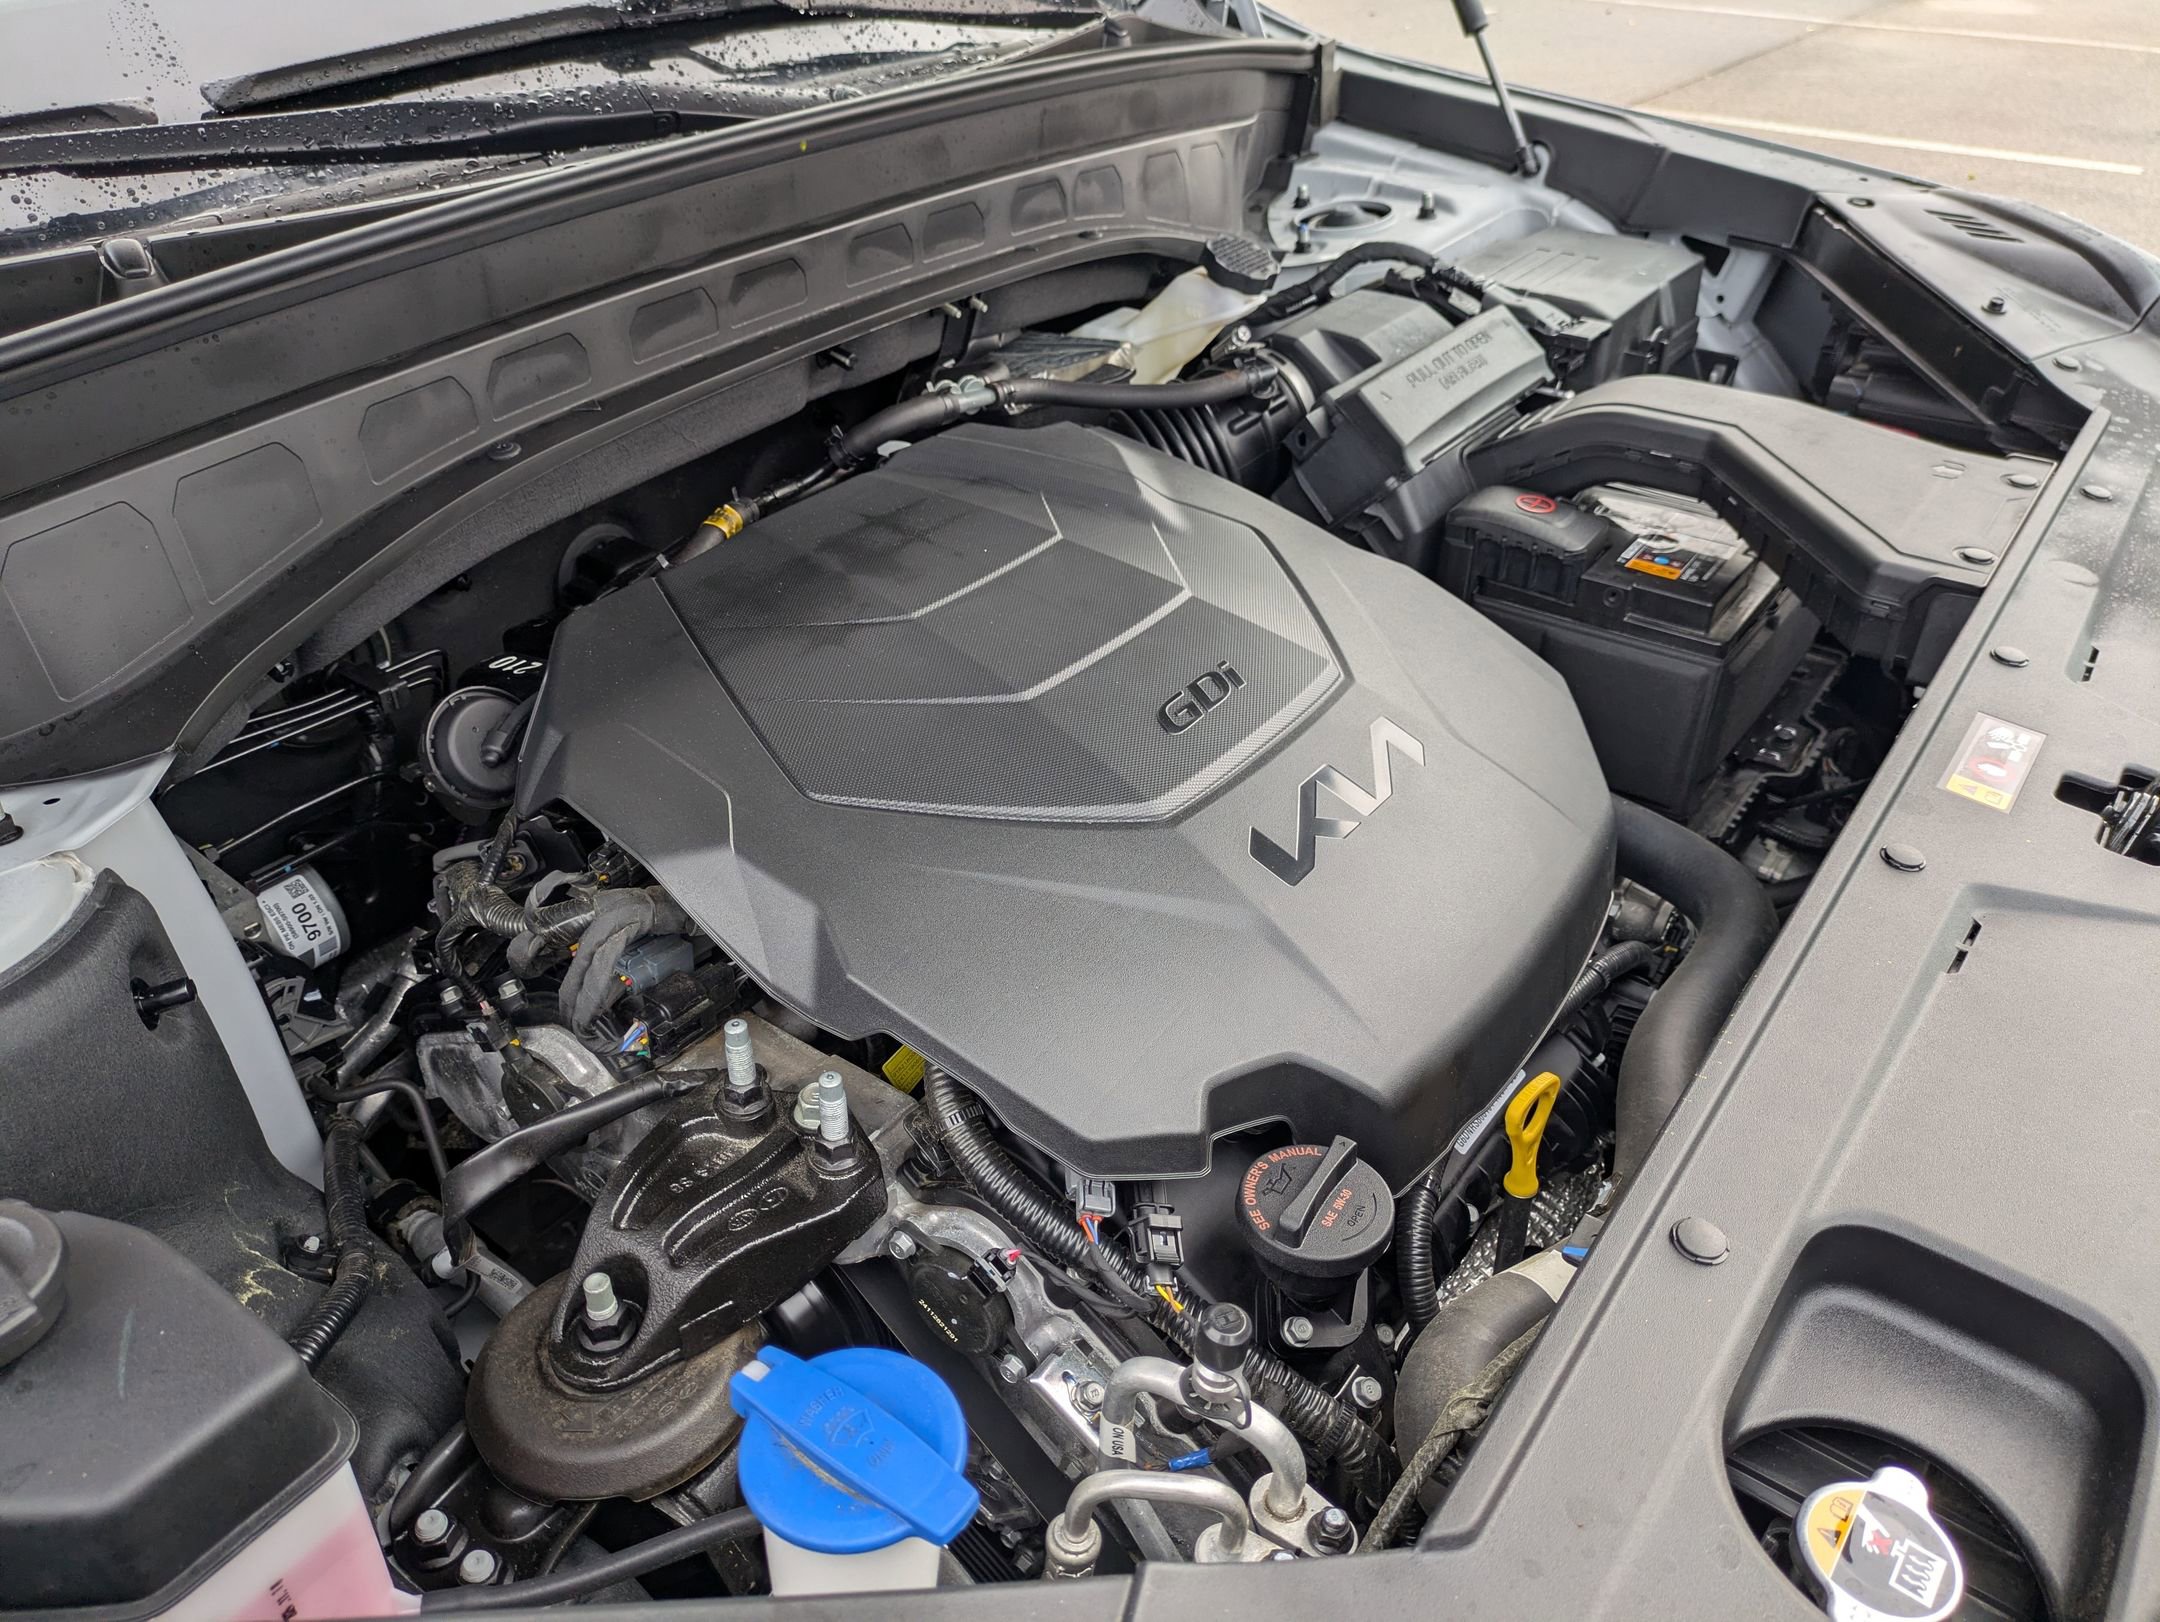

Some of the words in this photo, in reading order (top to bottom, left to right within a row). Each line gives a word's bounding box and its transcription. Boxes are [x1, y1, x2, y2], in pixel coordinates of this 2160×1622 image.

[488, 656, 543, 675] 210
[1157, 660, 1246, 735] GDi
[1248, 715, 1425, 886] KIA
[291, 902, 322, 941] 9700
[1268, 1147, 1322, 1163] MANUAL
[1244, 1161, 1269, 1205] OWNER'S
[1249, 1209, 1270, 1231] SEE
[1322, 1211, 1338, 1228] SAE
[1333, 1189, 1352, 1211] 5W-30
[1347, 1205, 1366, 1227] OPEN
[800, 1386, 844, 1427] WASHER
[1112, 1427, 1125, 1438] ON
[1112, 1440, 1124, 1455] USA
